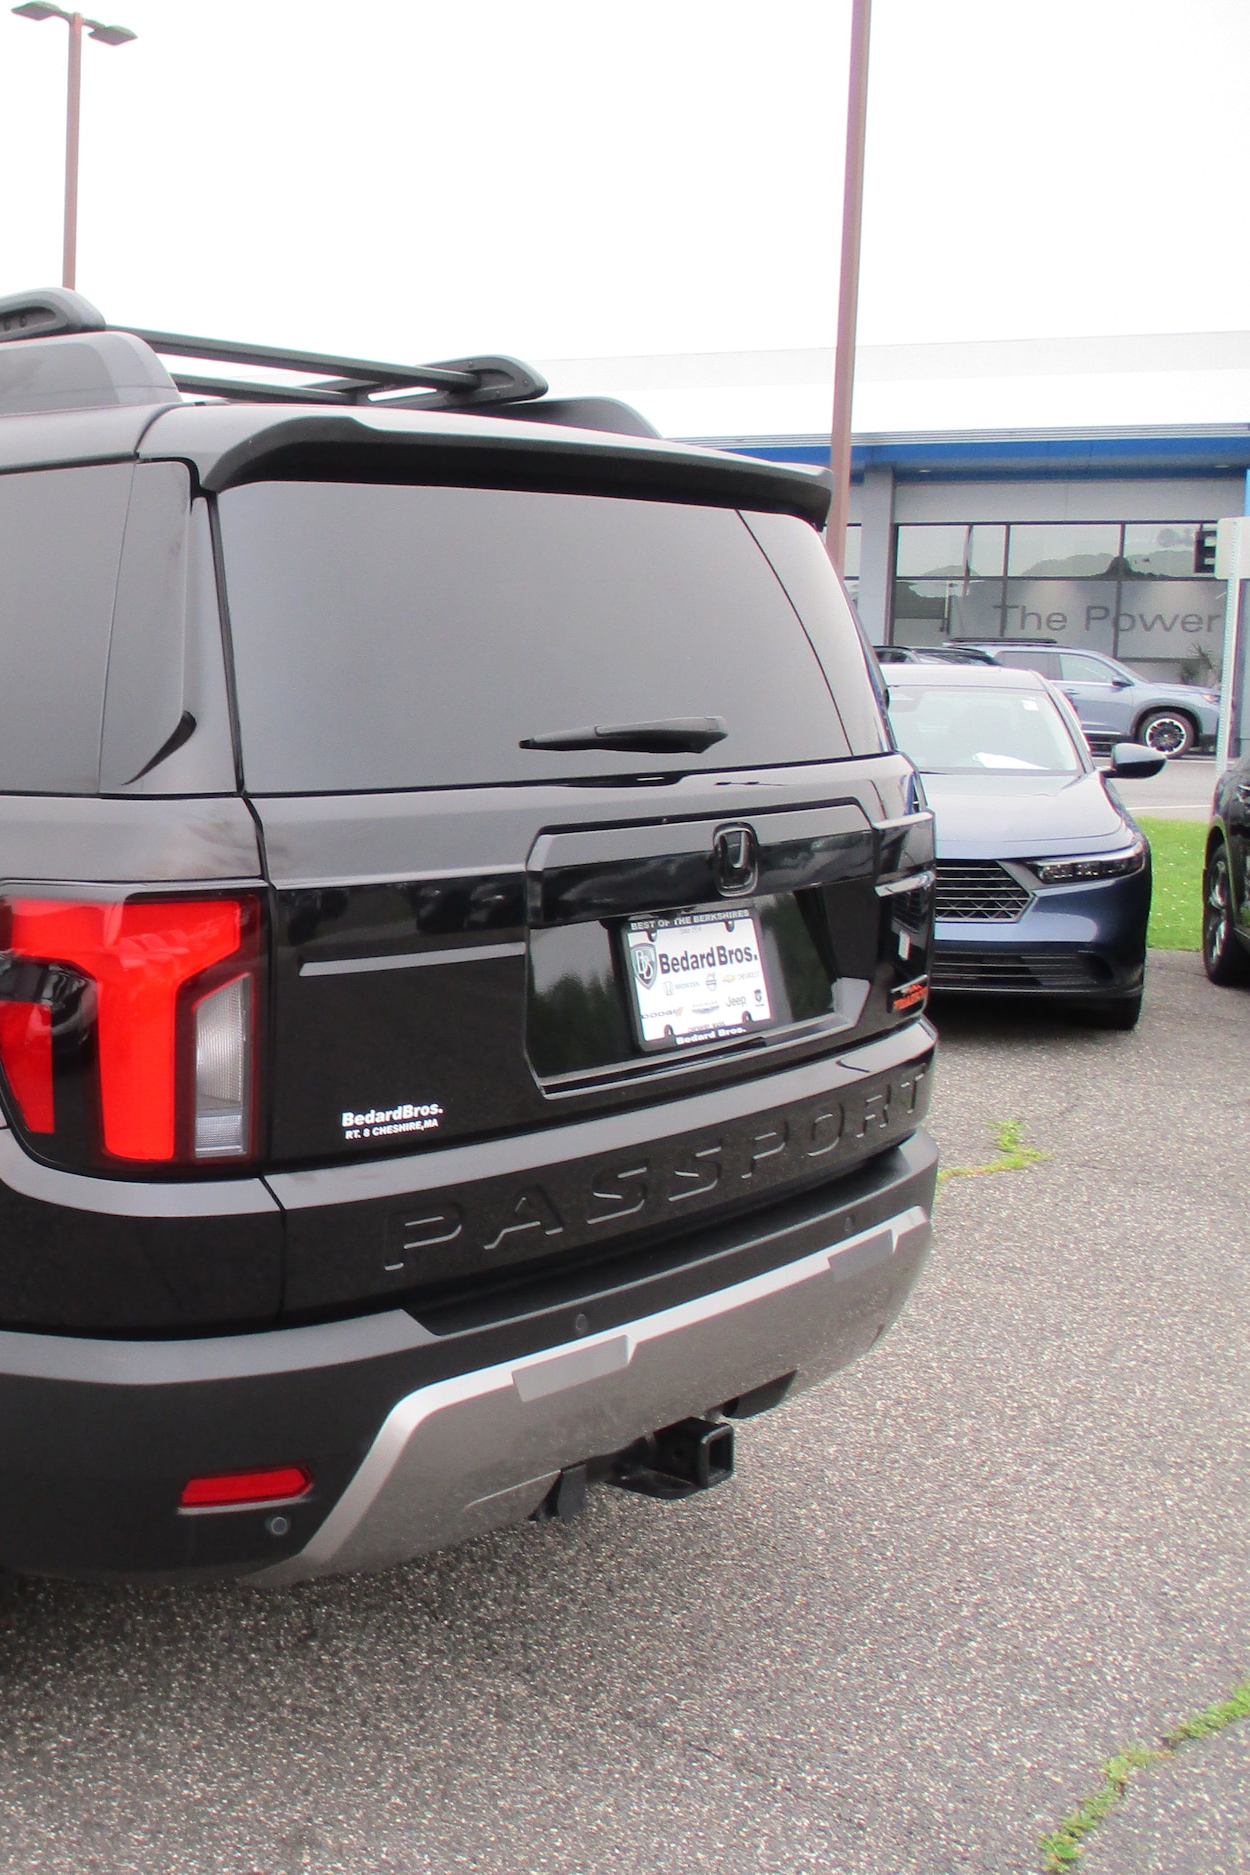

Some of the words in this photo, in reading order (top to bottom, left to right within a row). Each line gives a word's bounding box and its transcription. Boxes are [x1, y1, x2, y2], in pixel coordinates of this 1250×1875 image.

[993, 604, 1067, 632] The
[1085, 604, 1222, 633] Power
[630, 921, 655, 931] BEST
[673, 916, 692, 926] THE
[693, 909, 749, 923] BERKSHIRES
[726, 996, 747, 1008] Jeep
[675, 1030, 716, 1045] Bedard
[717, 1026, 747, 1037] Bros.
[345, 1129, 361, 1140] RT.
[385, 1072, 926, 1271] PASSPORT
